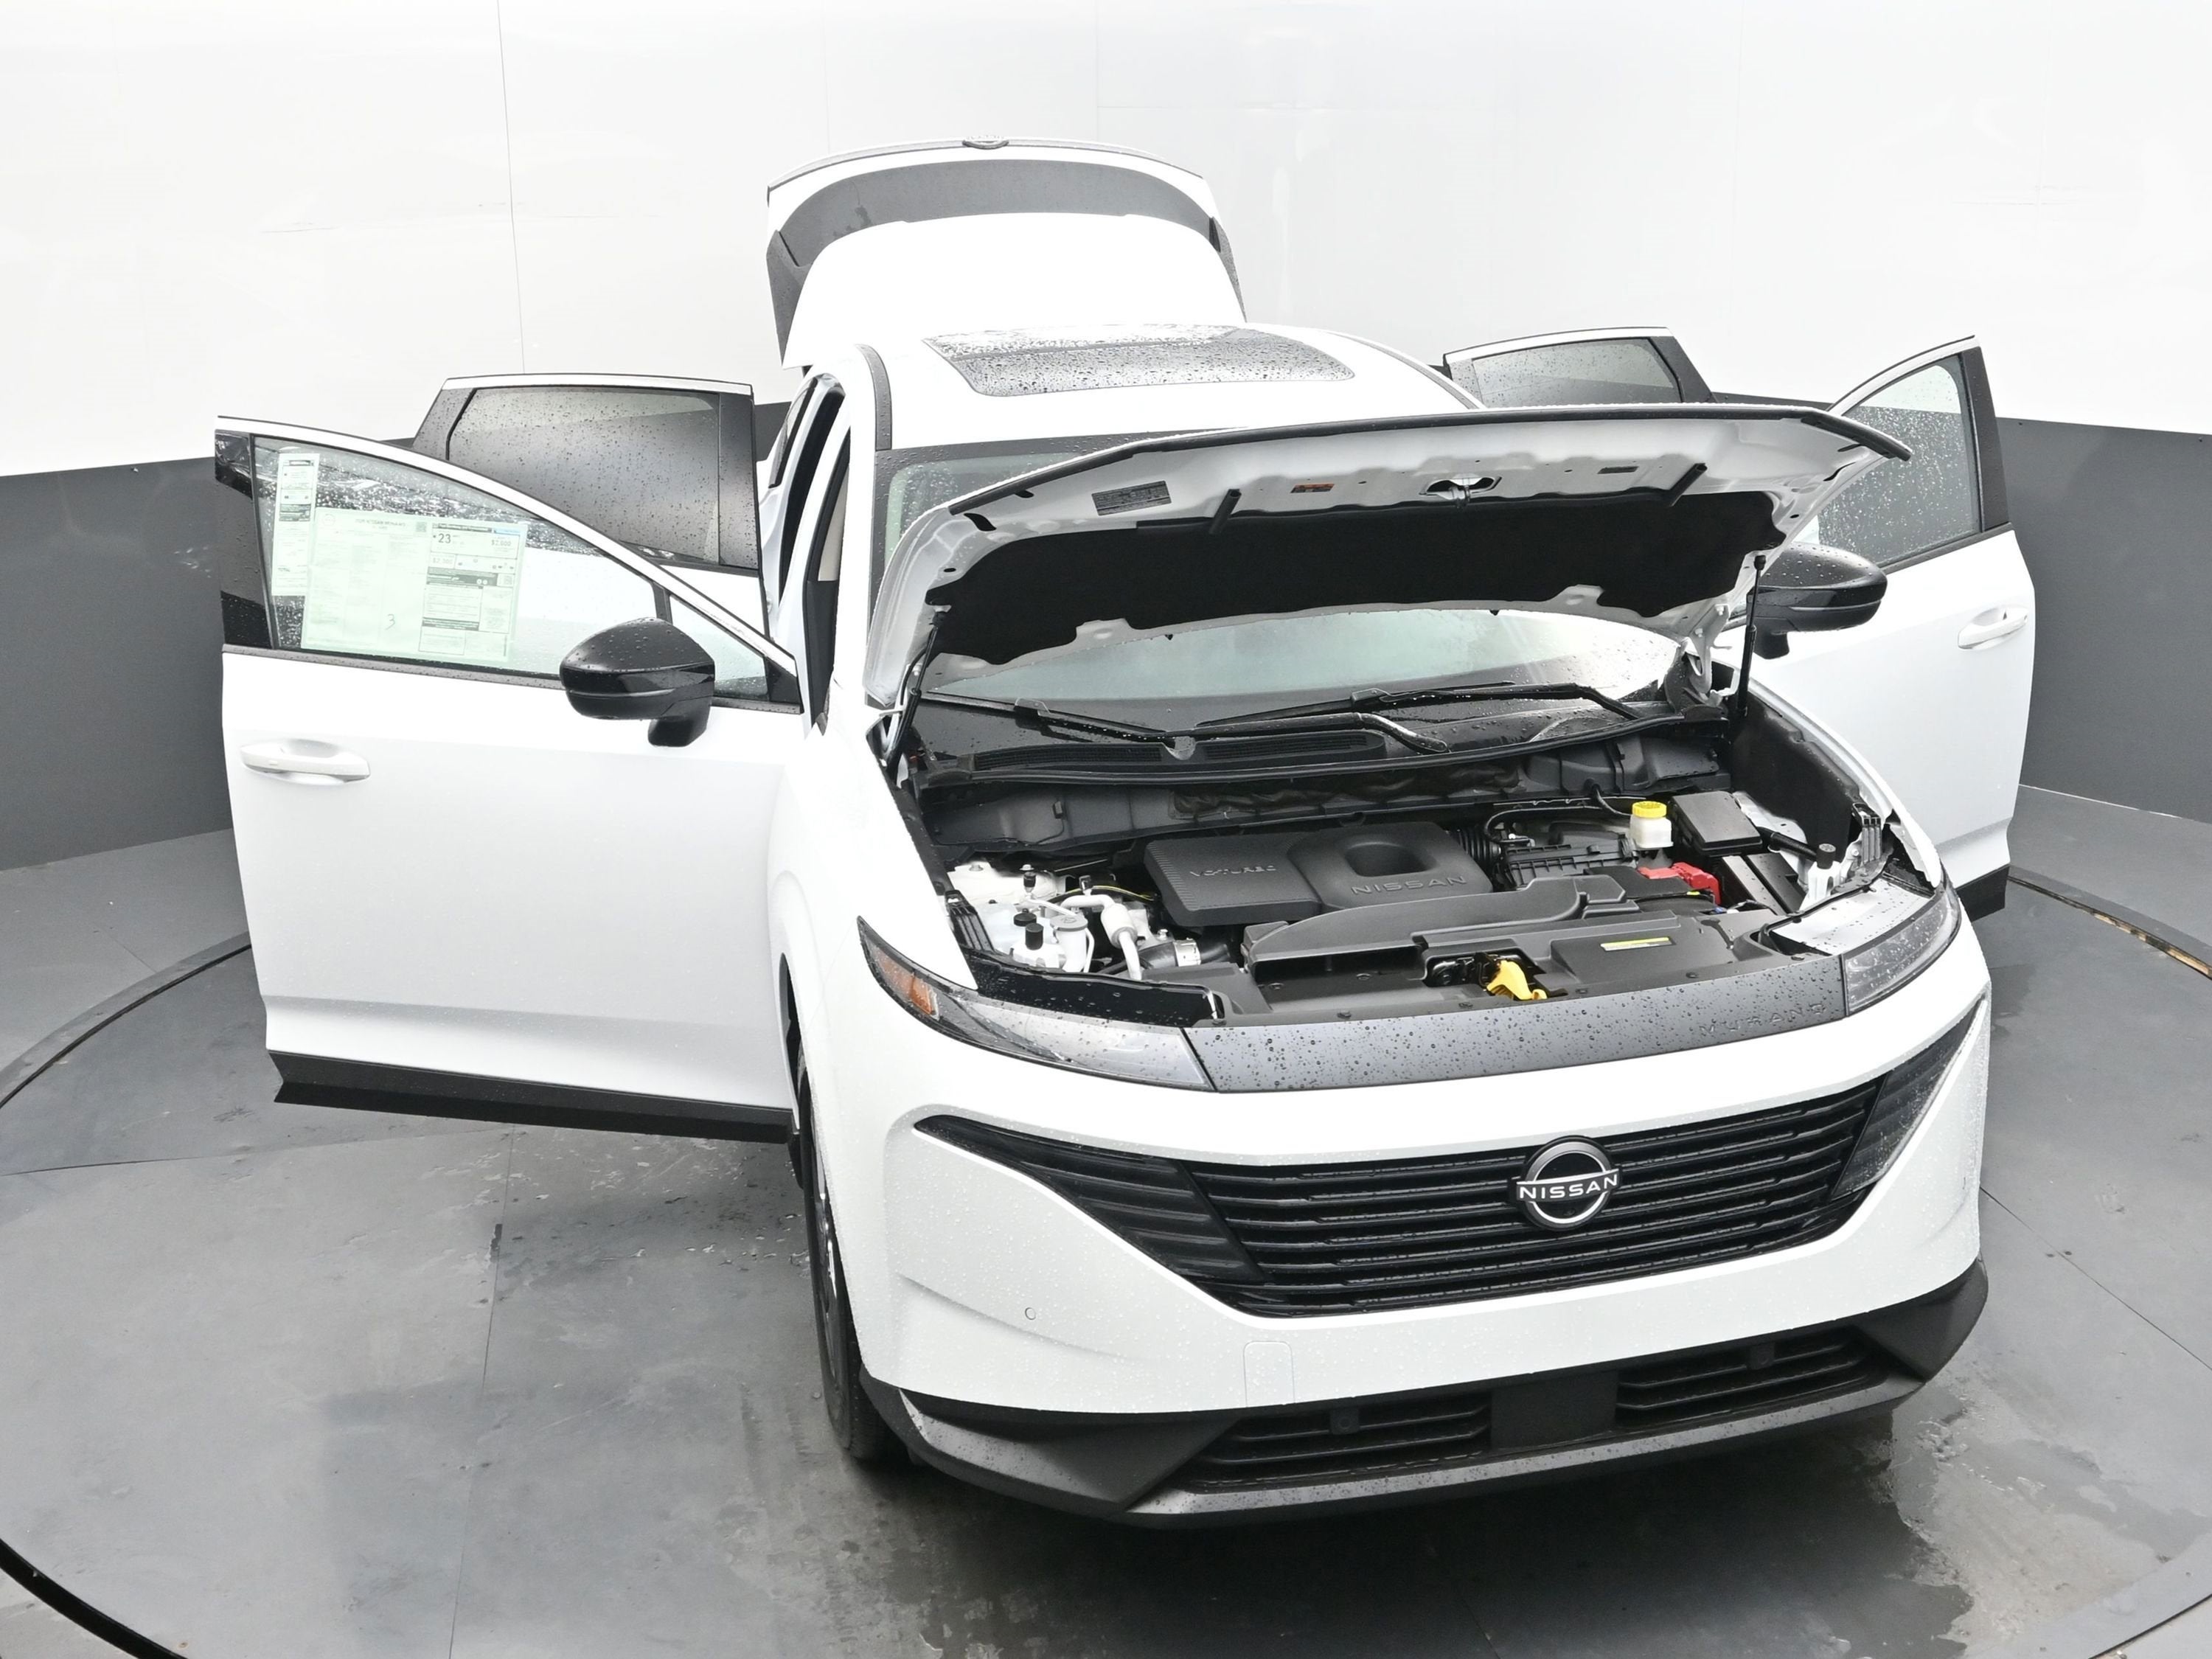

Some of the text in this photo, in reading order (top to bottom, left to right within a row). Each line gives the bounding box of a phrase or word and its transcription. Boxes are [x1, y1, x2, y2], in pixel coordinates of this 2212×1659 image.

[438, 532, 451, 544] 23
[1350, 875, 1467, 895] NISSAN
[1519, 1174, 1618, 1200] NISSAN
